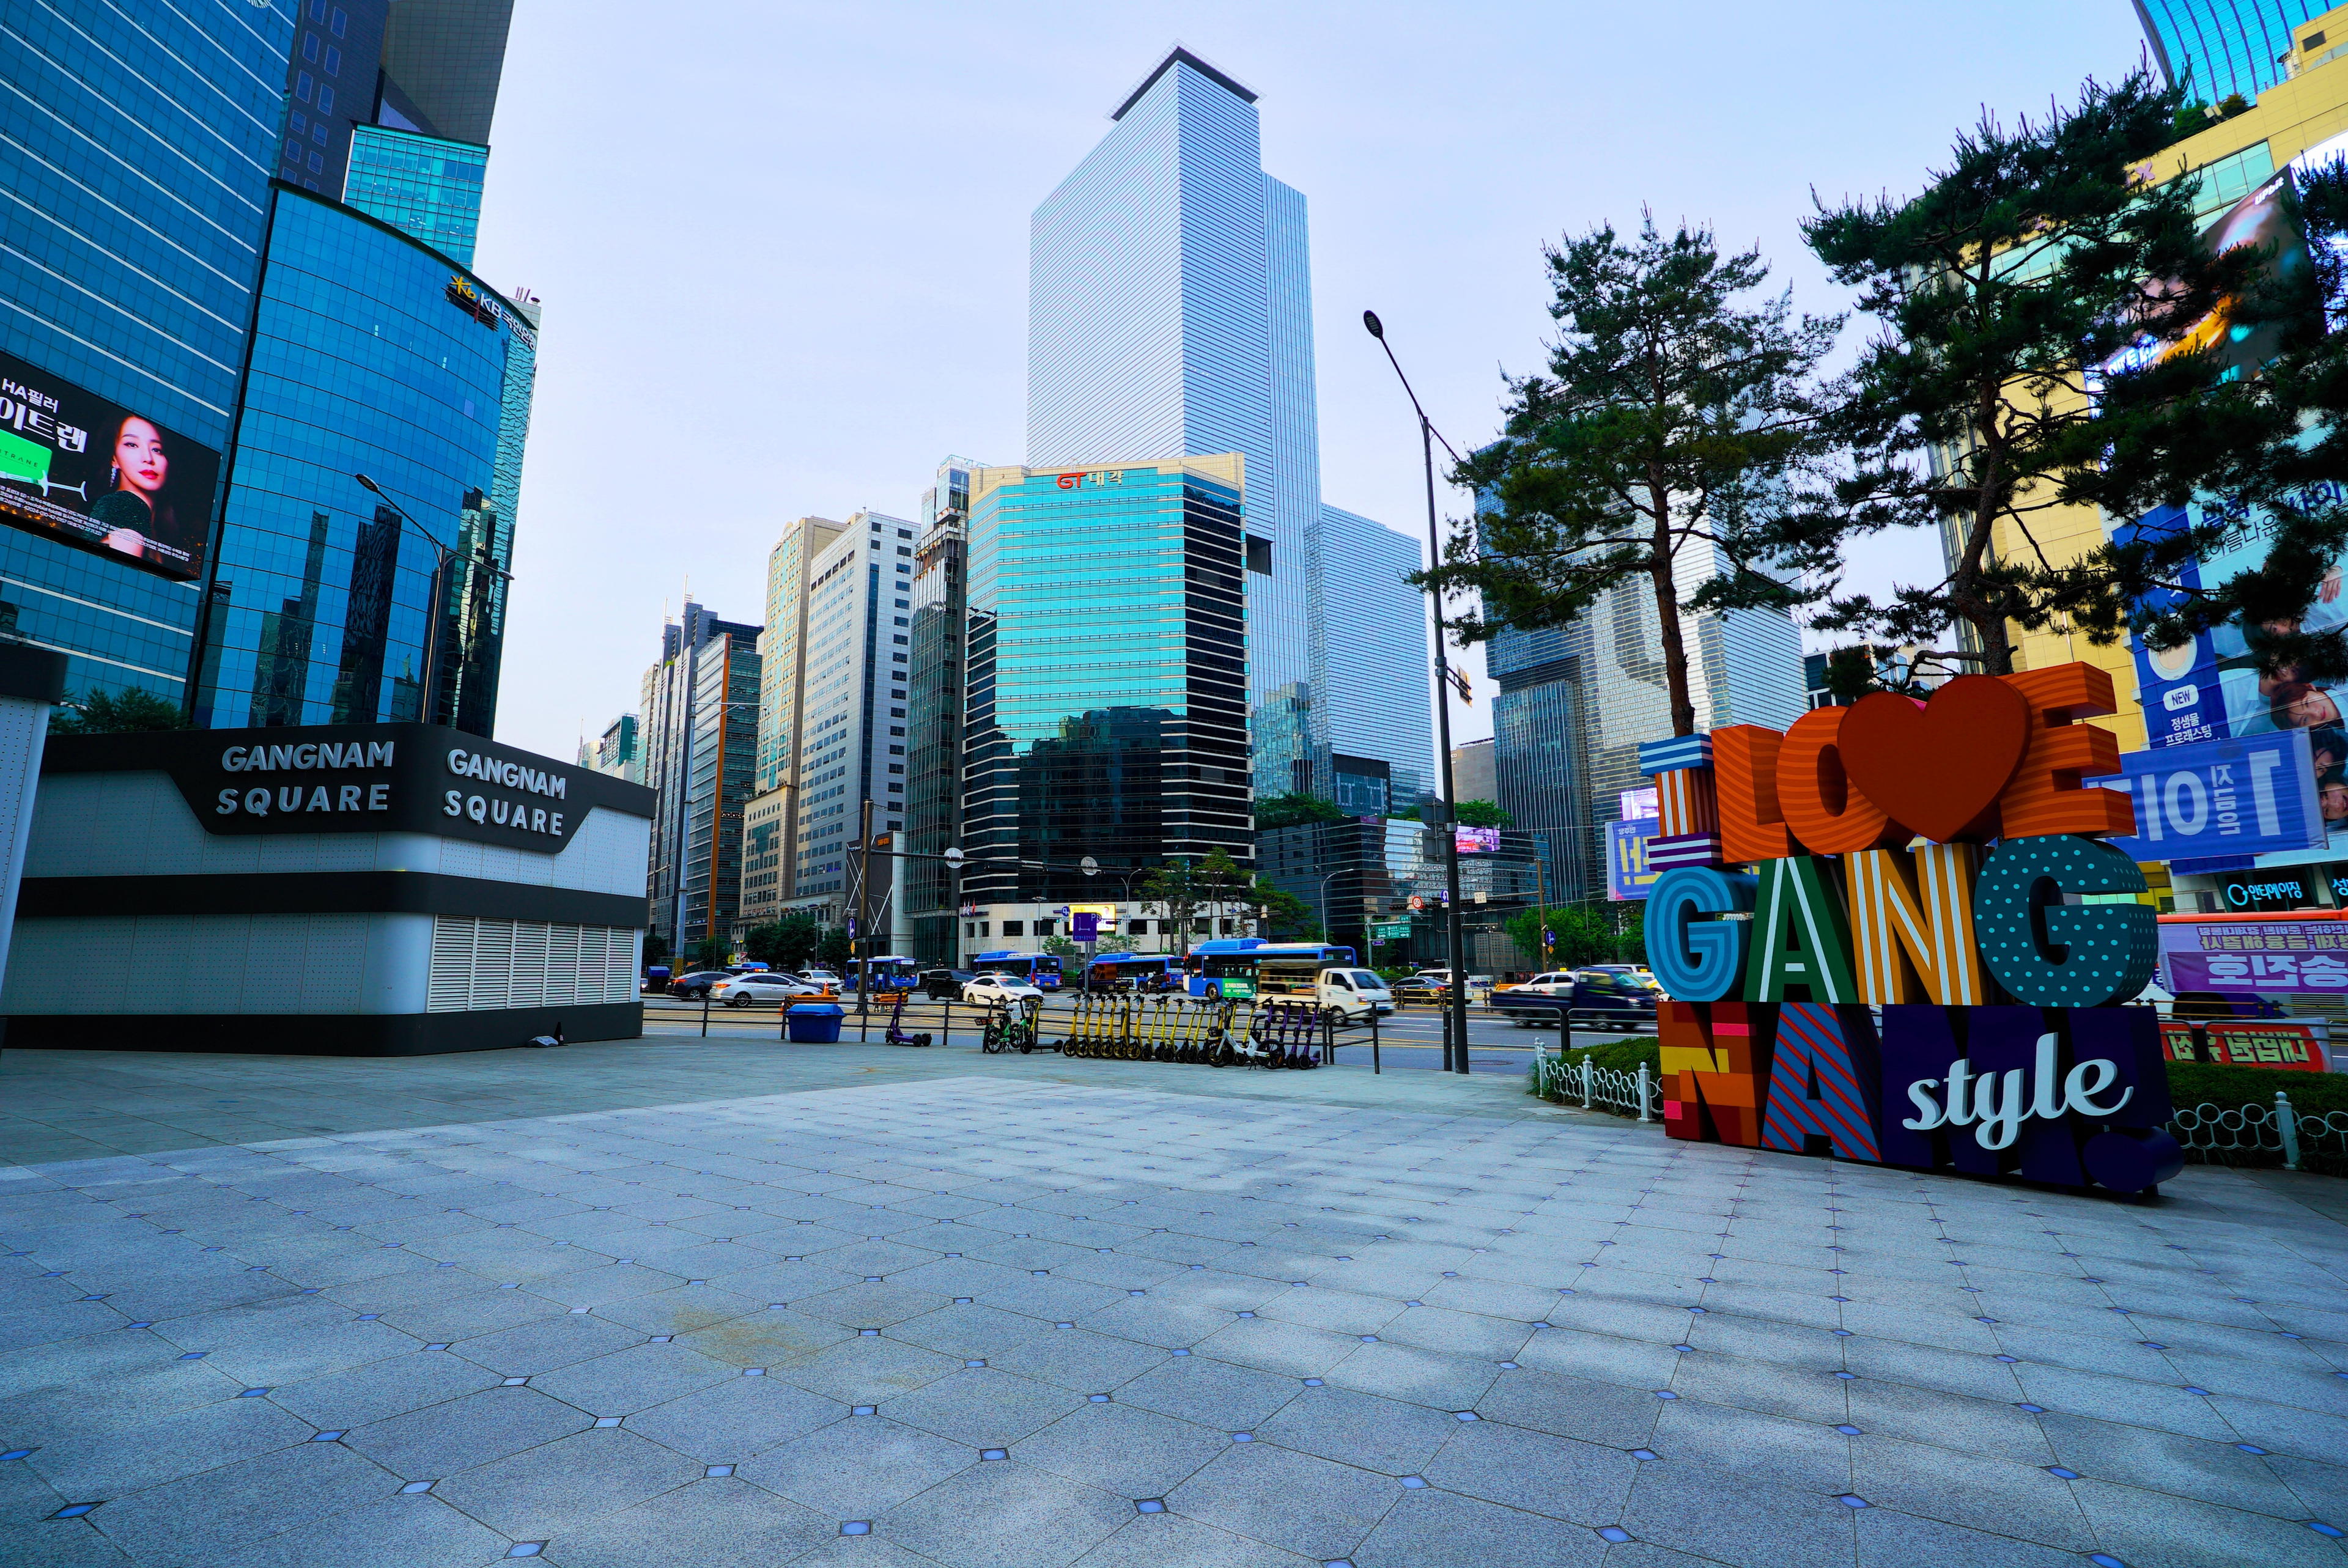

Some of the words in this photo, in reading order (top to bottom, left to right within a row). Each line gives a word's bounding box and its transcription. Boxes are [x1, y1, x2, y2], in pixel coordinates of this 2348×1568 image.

[2171, 689, 2190, 706] NEW
[2171, 712, 2200, 731] 정샘물
[222, 741, 394, 772] GANGNAM
[447, 748, 566, 800] GANGNAM
[216, 784, 390, 817] SQUARE
[443, 790, 564, 836] SQUARE
[2248, 882, 2303, 900] 안티에이징
[1644, 834, 2159, 1008] GANG
[1902, 1032, 2134, 1150] style
